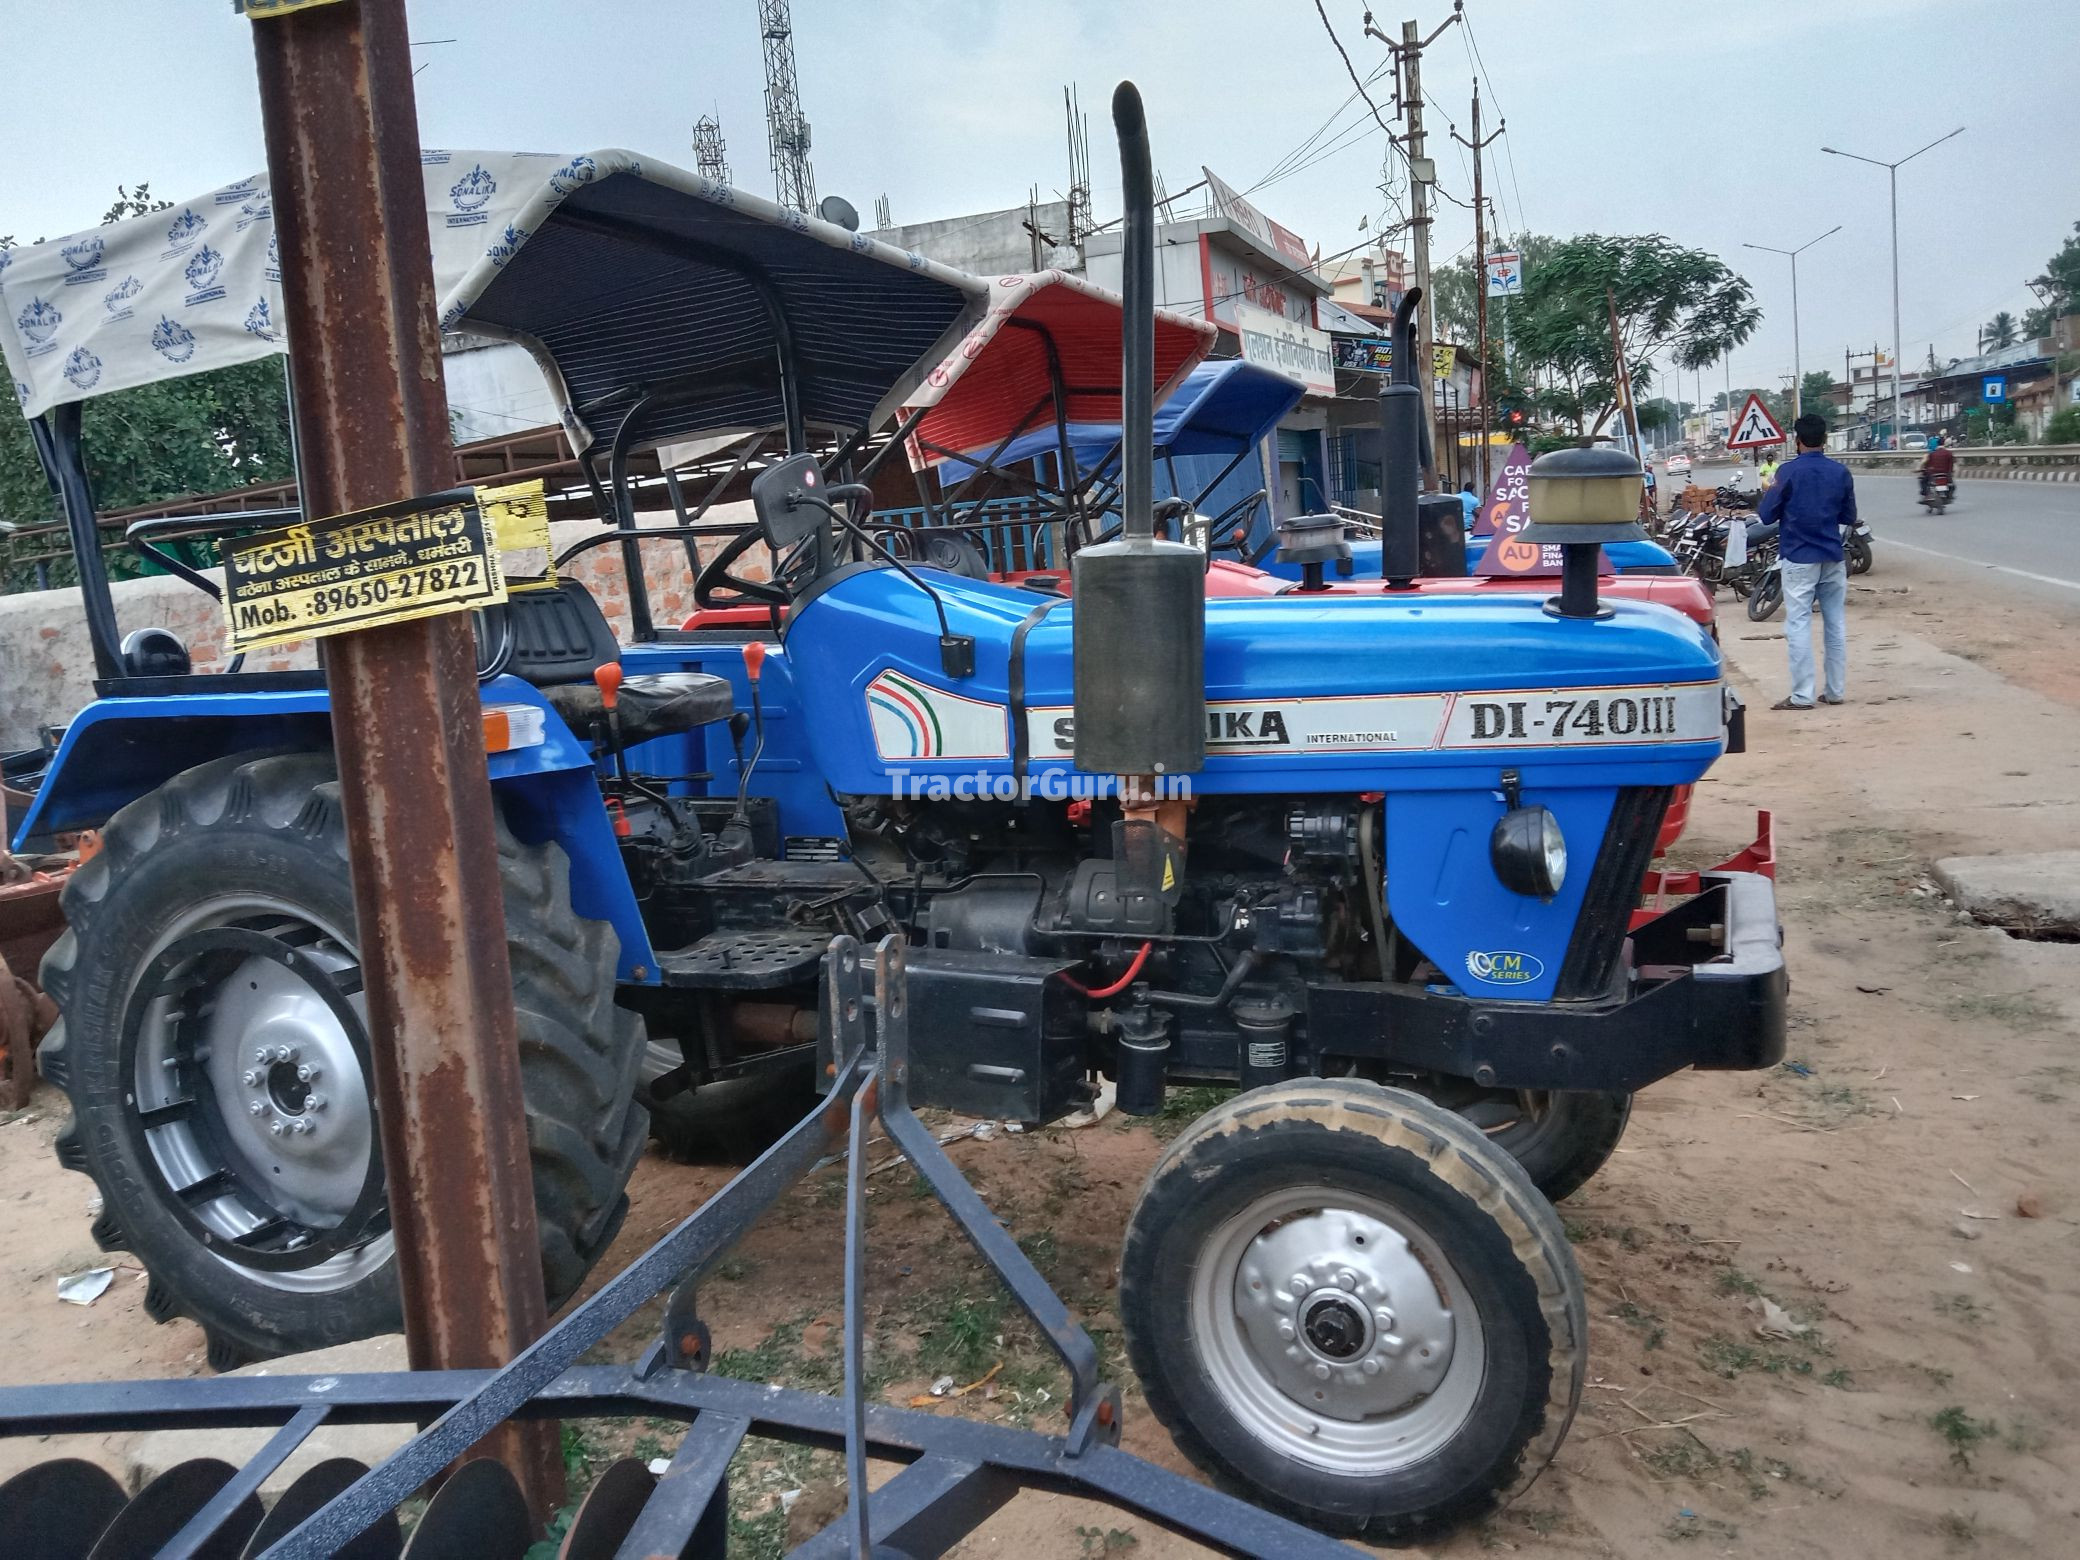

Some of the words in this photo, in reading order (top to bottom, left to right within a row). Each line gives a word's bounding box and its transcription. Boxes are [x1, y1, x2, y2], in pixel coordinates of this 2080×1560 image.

[449, 182, 496, 197] SONALIKA
[61, 239, 105, 257] SONALIKA
[1497, 268, 1512, 278] HP
[18, 312, 62, 330] SONALIKA
[244, 318, 272, 334] SONA
[151, 331, 196, 351] SONALIKA
[63, 355, 103, 378] SONALIKA
[325, 503, 466, 557] अस्पताल
[1503, 545, 1533, 560] AU
[275, 564, 342, 590] अस्पताल
[342, 557, 361, 579] के
[240, 598, 297, 629] Mob.
[1306, 732, 1397, 744] INTERNATIONAL
[1491, 955, 1522, 971] CM
[1491, 971, 1531, 980] SERIES
